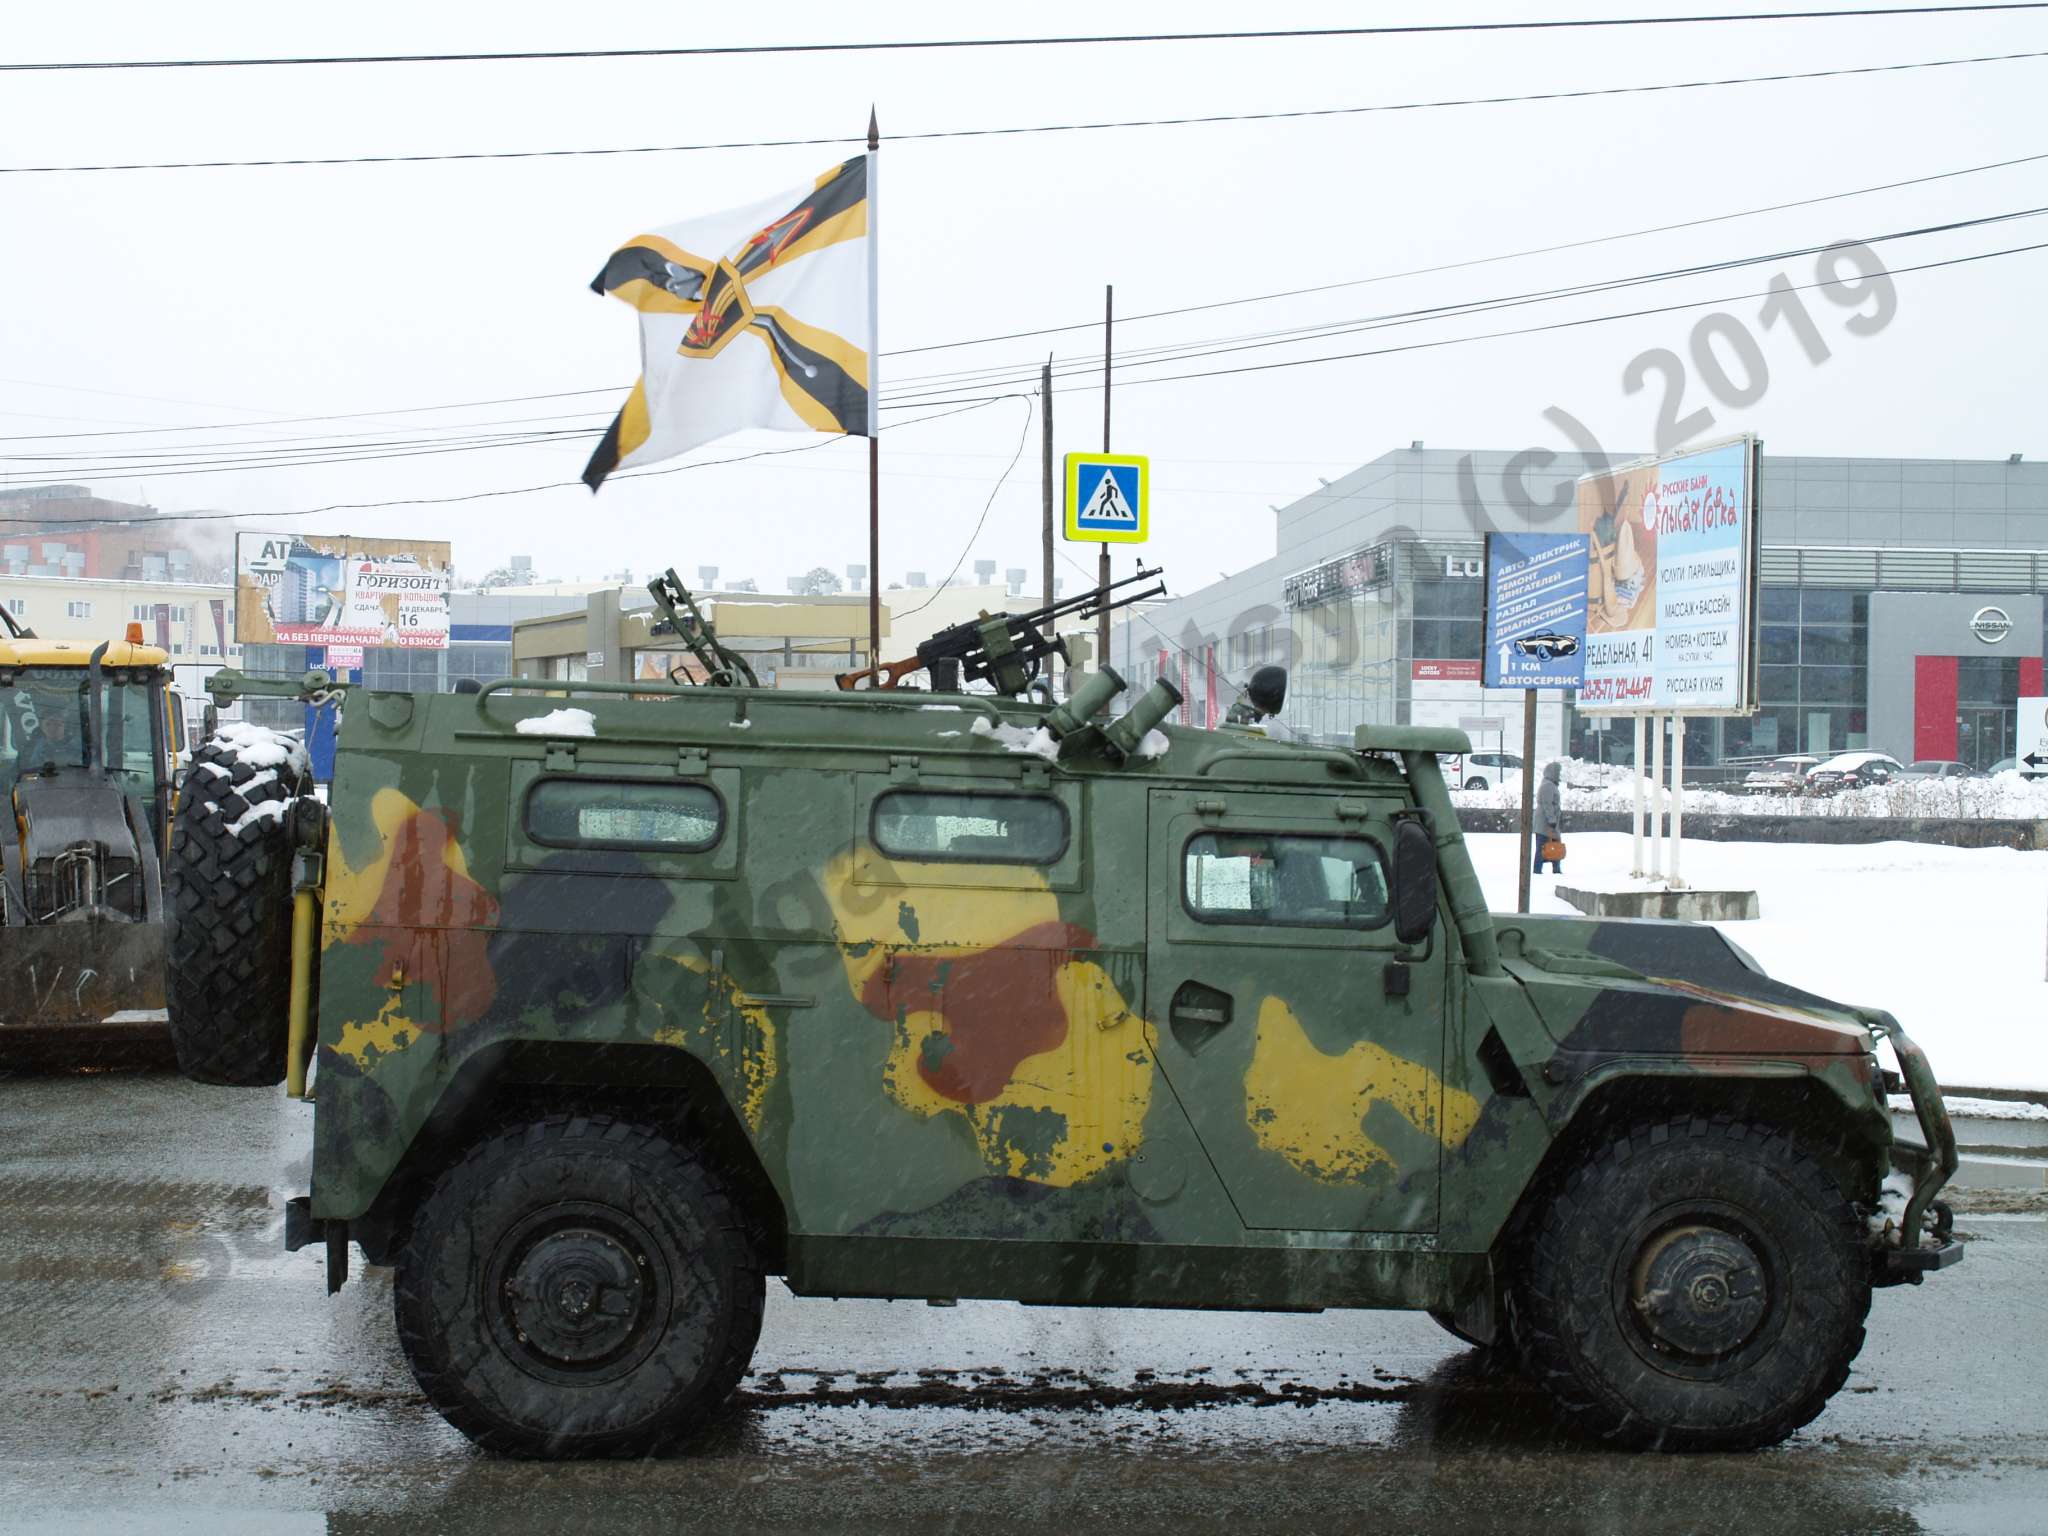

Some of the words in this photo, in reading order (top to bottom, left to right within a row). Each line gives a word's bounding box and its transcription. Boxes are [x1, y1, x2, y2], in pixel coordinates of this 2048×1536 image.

[1663, 479, 1688, 497] РУССКИЕ
[1498, 561, 1524, 577] АВТО
[1528, 540, 1581, 565] ЭЛЕКТРИК
[356, 576, 440, 589] ГОРИЗОНТ
[1497, 571, 1538, 593] РЕМОНТ
[1661, 567, 1685, 583] УСЛУГИ
[1688, 560, 1736, 580] ПАРИЛЬЩИКА
[1497, 572, 1562, 602] ДВИГАТЕЛЕЙ
[1496, 598, 1537, 620] РАЗВАЛ
[1665, 602, 1695, 618] МАССАЖ
[1700, 595, 1730, 614] БАССЕЙН
[1496, 603, 1573, 638] ДИАГНОСТИКА
[292, 633, 308, 642] БЕЗ
[1643, 635, 1652, 662] 41
[1665, 633, 1692, 649] НОМЕРА
[1697, 631, 1728, 648] КОТТЕДЖ
[1521, 663, 1541, 671] КМ
[1499, 676, 1580, 685] АВТОСЕРВИС
[1667, 678, 1697, 693] РУССКАЯ
[1700, 677, 1724, 692] КУХНЯ
